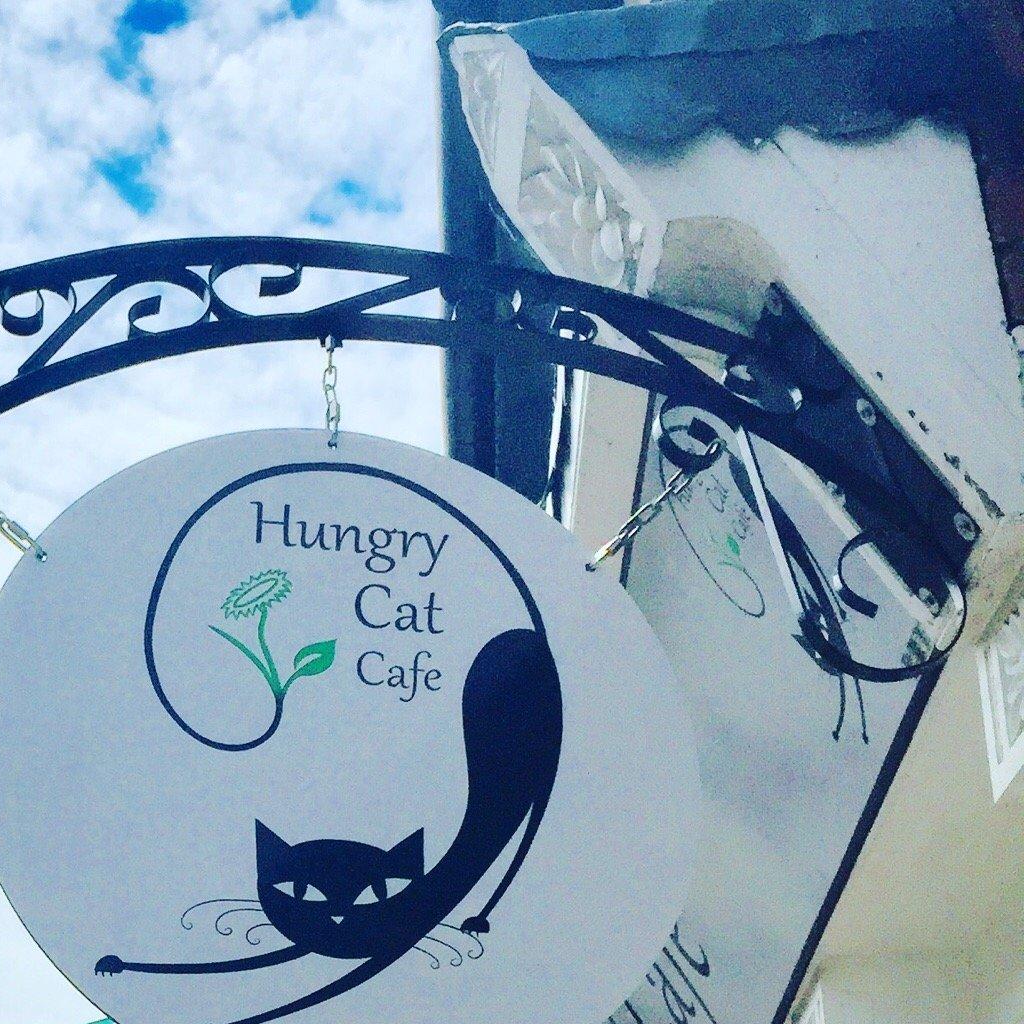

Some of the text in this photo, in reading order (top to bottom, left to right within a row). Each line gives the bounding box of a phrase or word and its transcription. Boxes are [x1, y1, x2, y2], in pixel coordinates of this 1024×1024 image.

[250, 501, 449, 577] Hungry
[354, 583, 444, 635] Cat
[356, 650, 443, 702] Cafe
